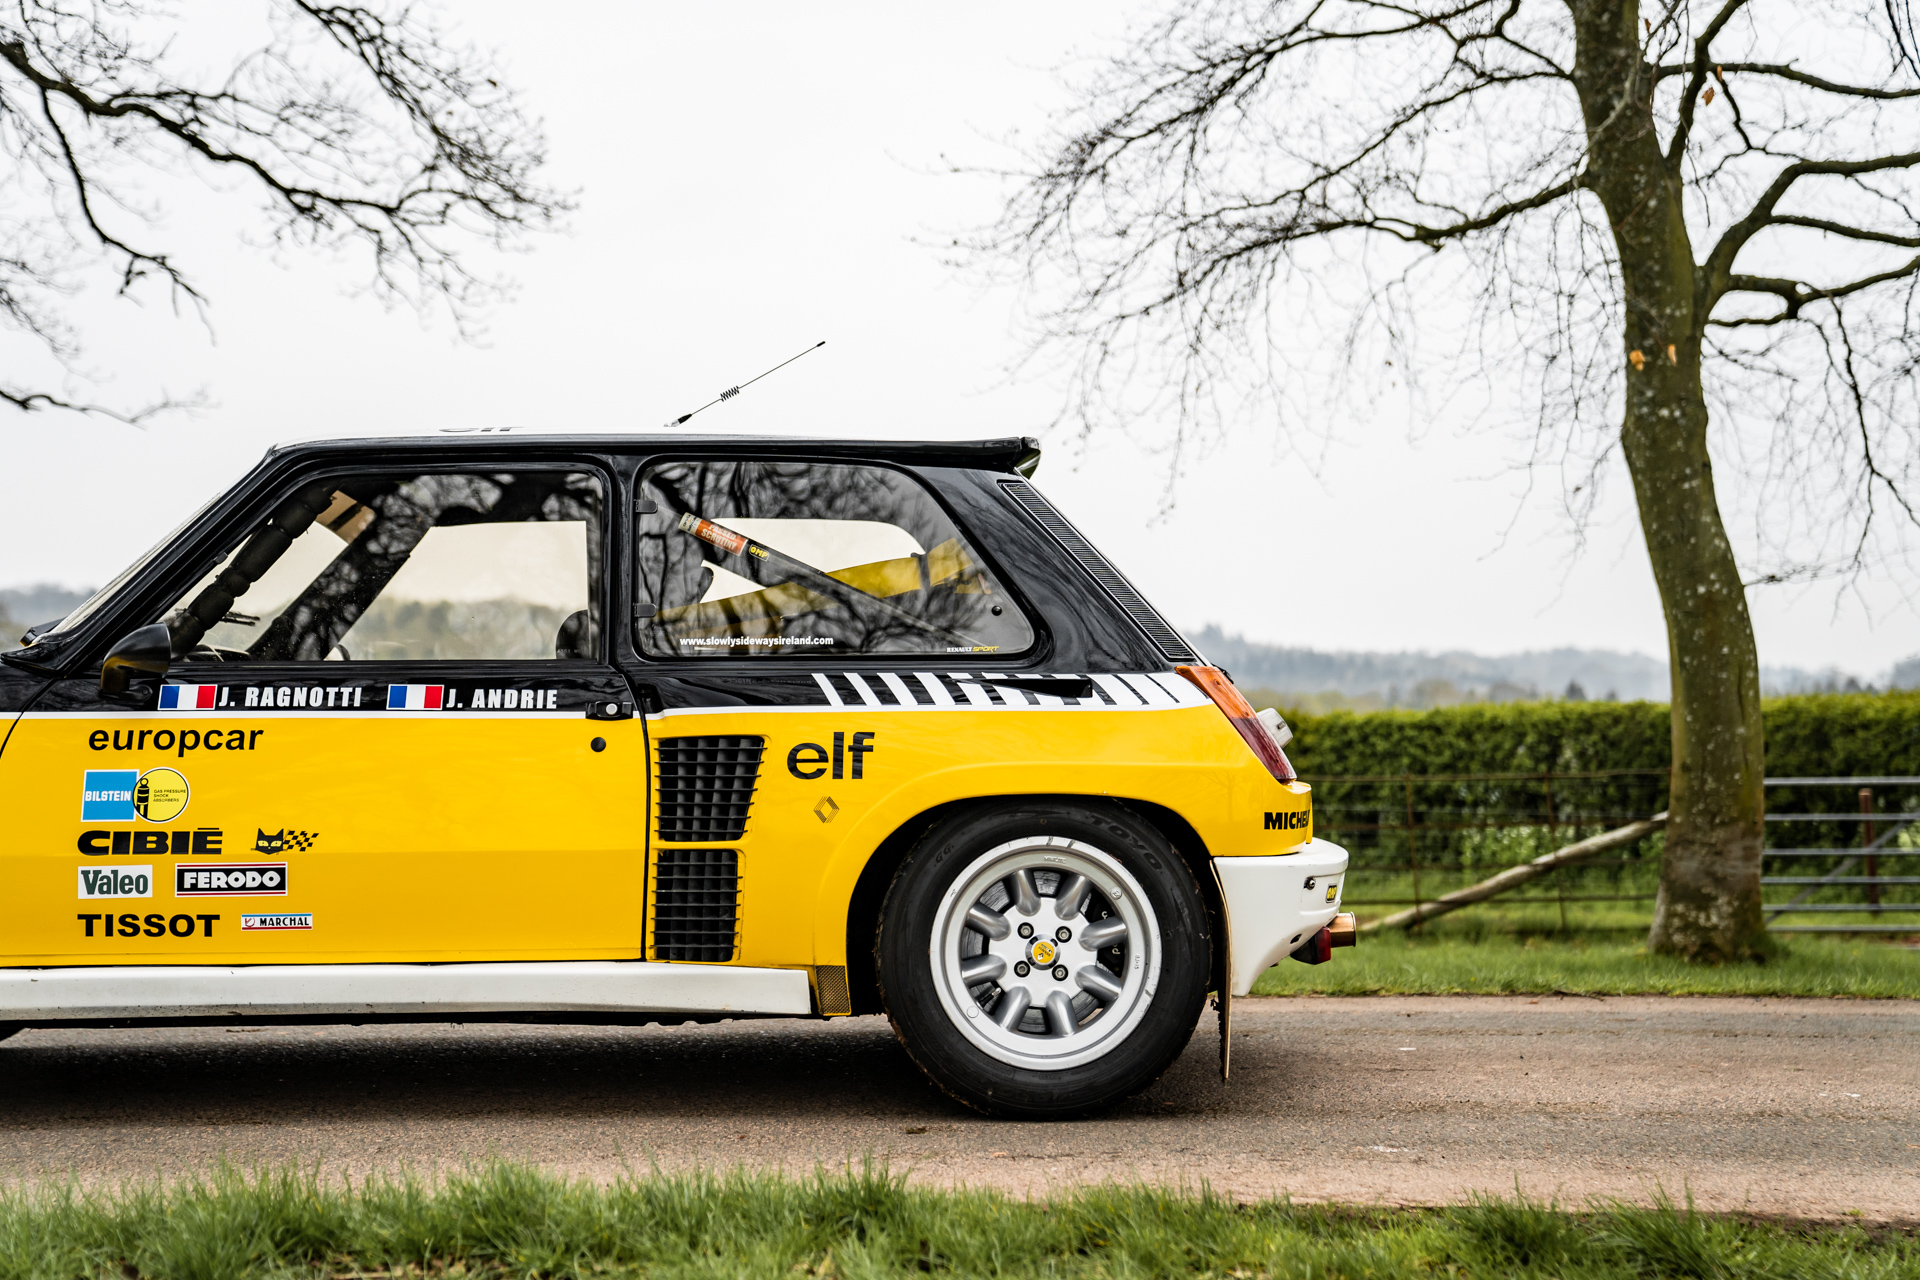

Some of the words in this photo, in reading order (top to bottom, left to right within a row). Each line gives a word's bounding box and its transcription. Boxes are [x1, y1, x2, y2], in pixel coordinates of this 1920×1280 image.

[701, 529, 737, 550] SCRUTINY
[709, 524, 736, 539] PASSED
[750, 546, 769, 558] OMP
[679, 636, 834, 647] www.slowlysidewaysireland.com
[218, 686, 235, 707] J.
[244, 686, 362, 707] RAGNOTTI
[446, 688, 463, 708] J.
[471, 688, 558, 709] ANDRIE
[88, 728, 264, 758] europcar
[786, 731, 876, 780] elf
[84, 790, 132, 802] BILSTEIN
[1090, 813, 1163, 870] TOYO
[80, 869, 149, 895] Valeo
[183, 870, 281, 889] FERODO
[77, 913, 221, 938] TISSOT
[259, 916, 310, 927] MARCHAL
